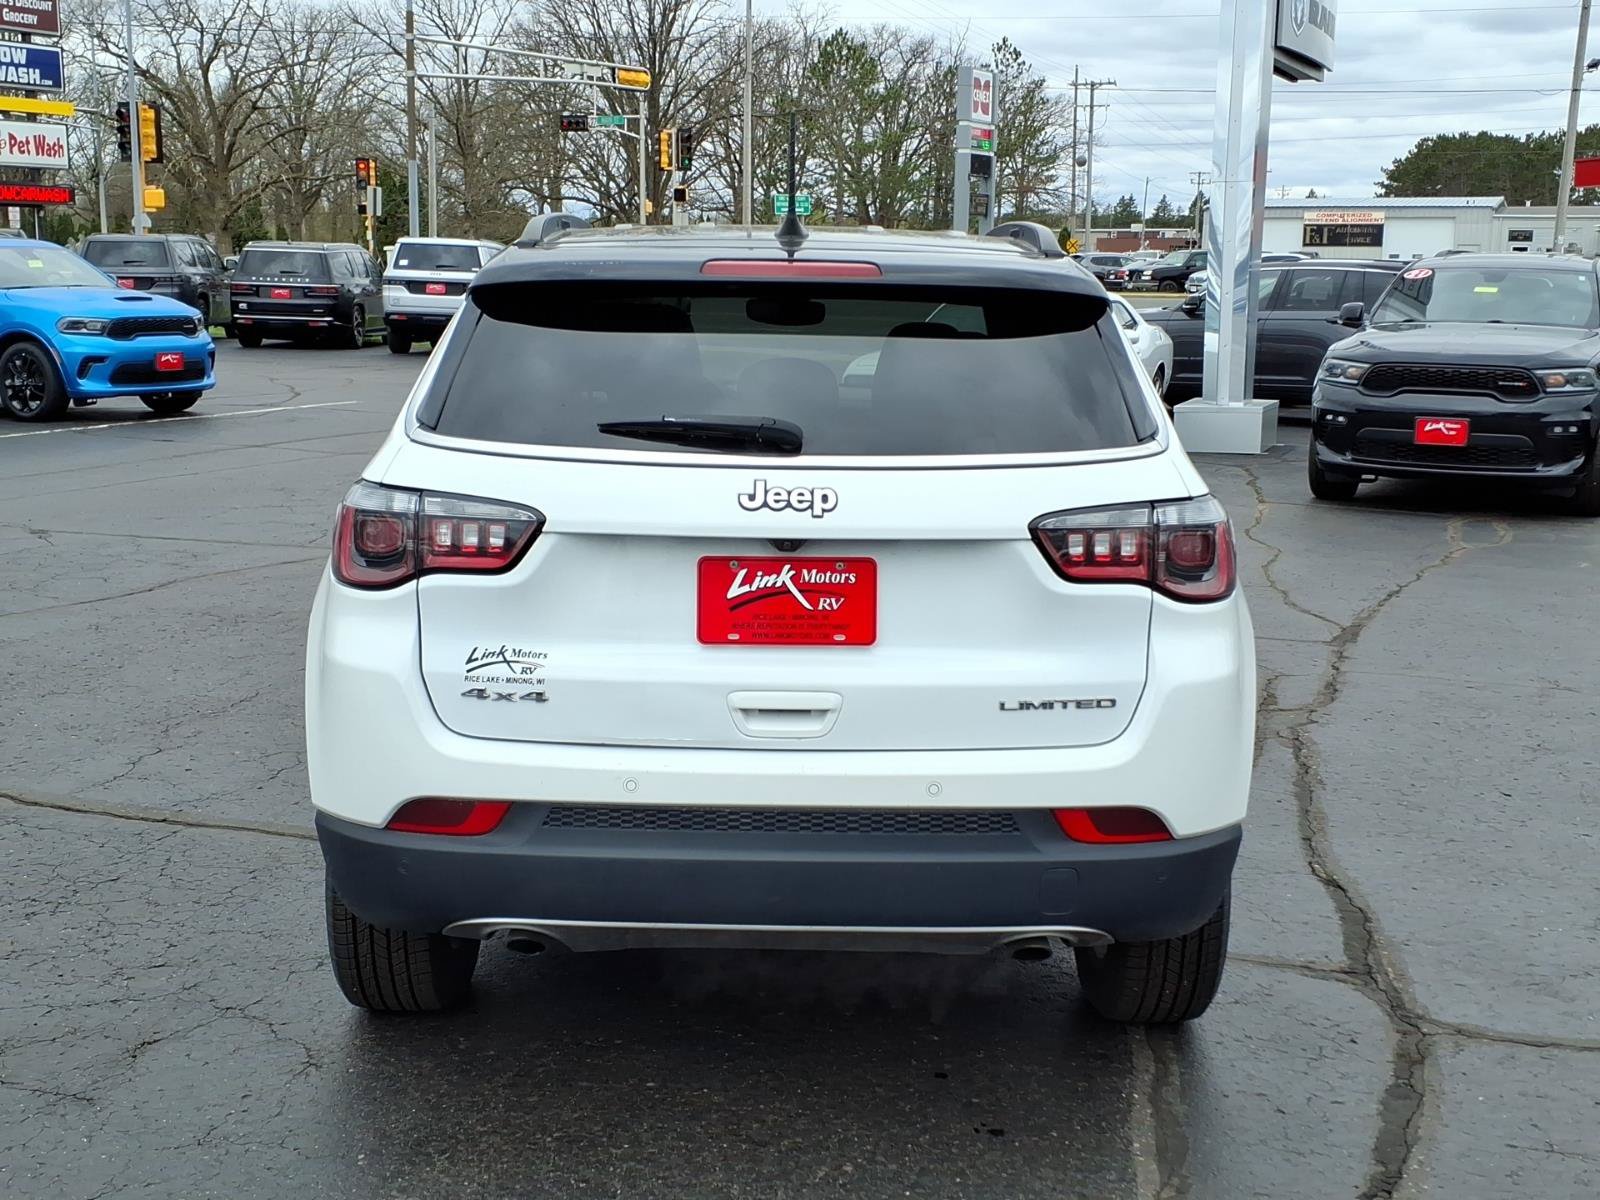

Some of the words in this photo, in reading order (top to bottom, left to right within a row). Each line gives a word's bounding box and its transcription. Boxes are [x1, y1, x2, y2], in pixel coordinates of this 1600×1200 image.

[7, 131, 31, 156] Pet
[33, 134, 65, 159] Wash
[737, 479, 839, 518] Jeep
[726, 564, 814, 610] Link
[800, 568, 856, 584] Motors
[816, 597, 845, 611] RV
[465, 644, 517, 674] Link
[510, 648, 548, 660] Motors
[464, 675, 480, 683] RICE
[520, 666, 537, 675] RV
[999, 699, 1117, 711] LIMITED
